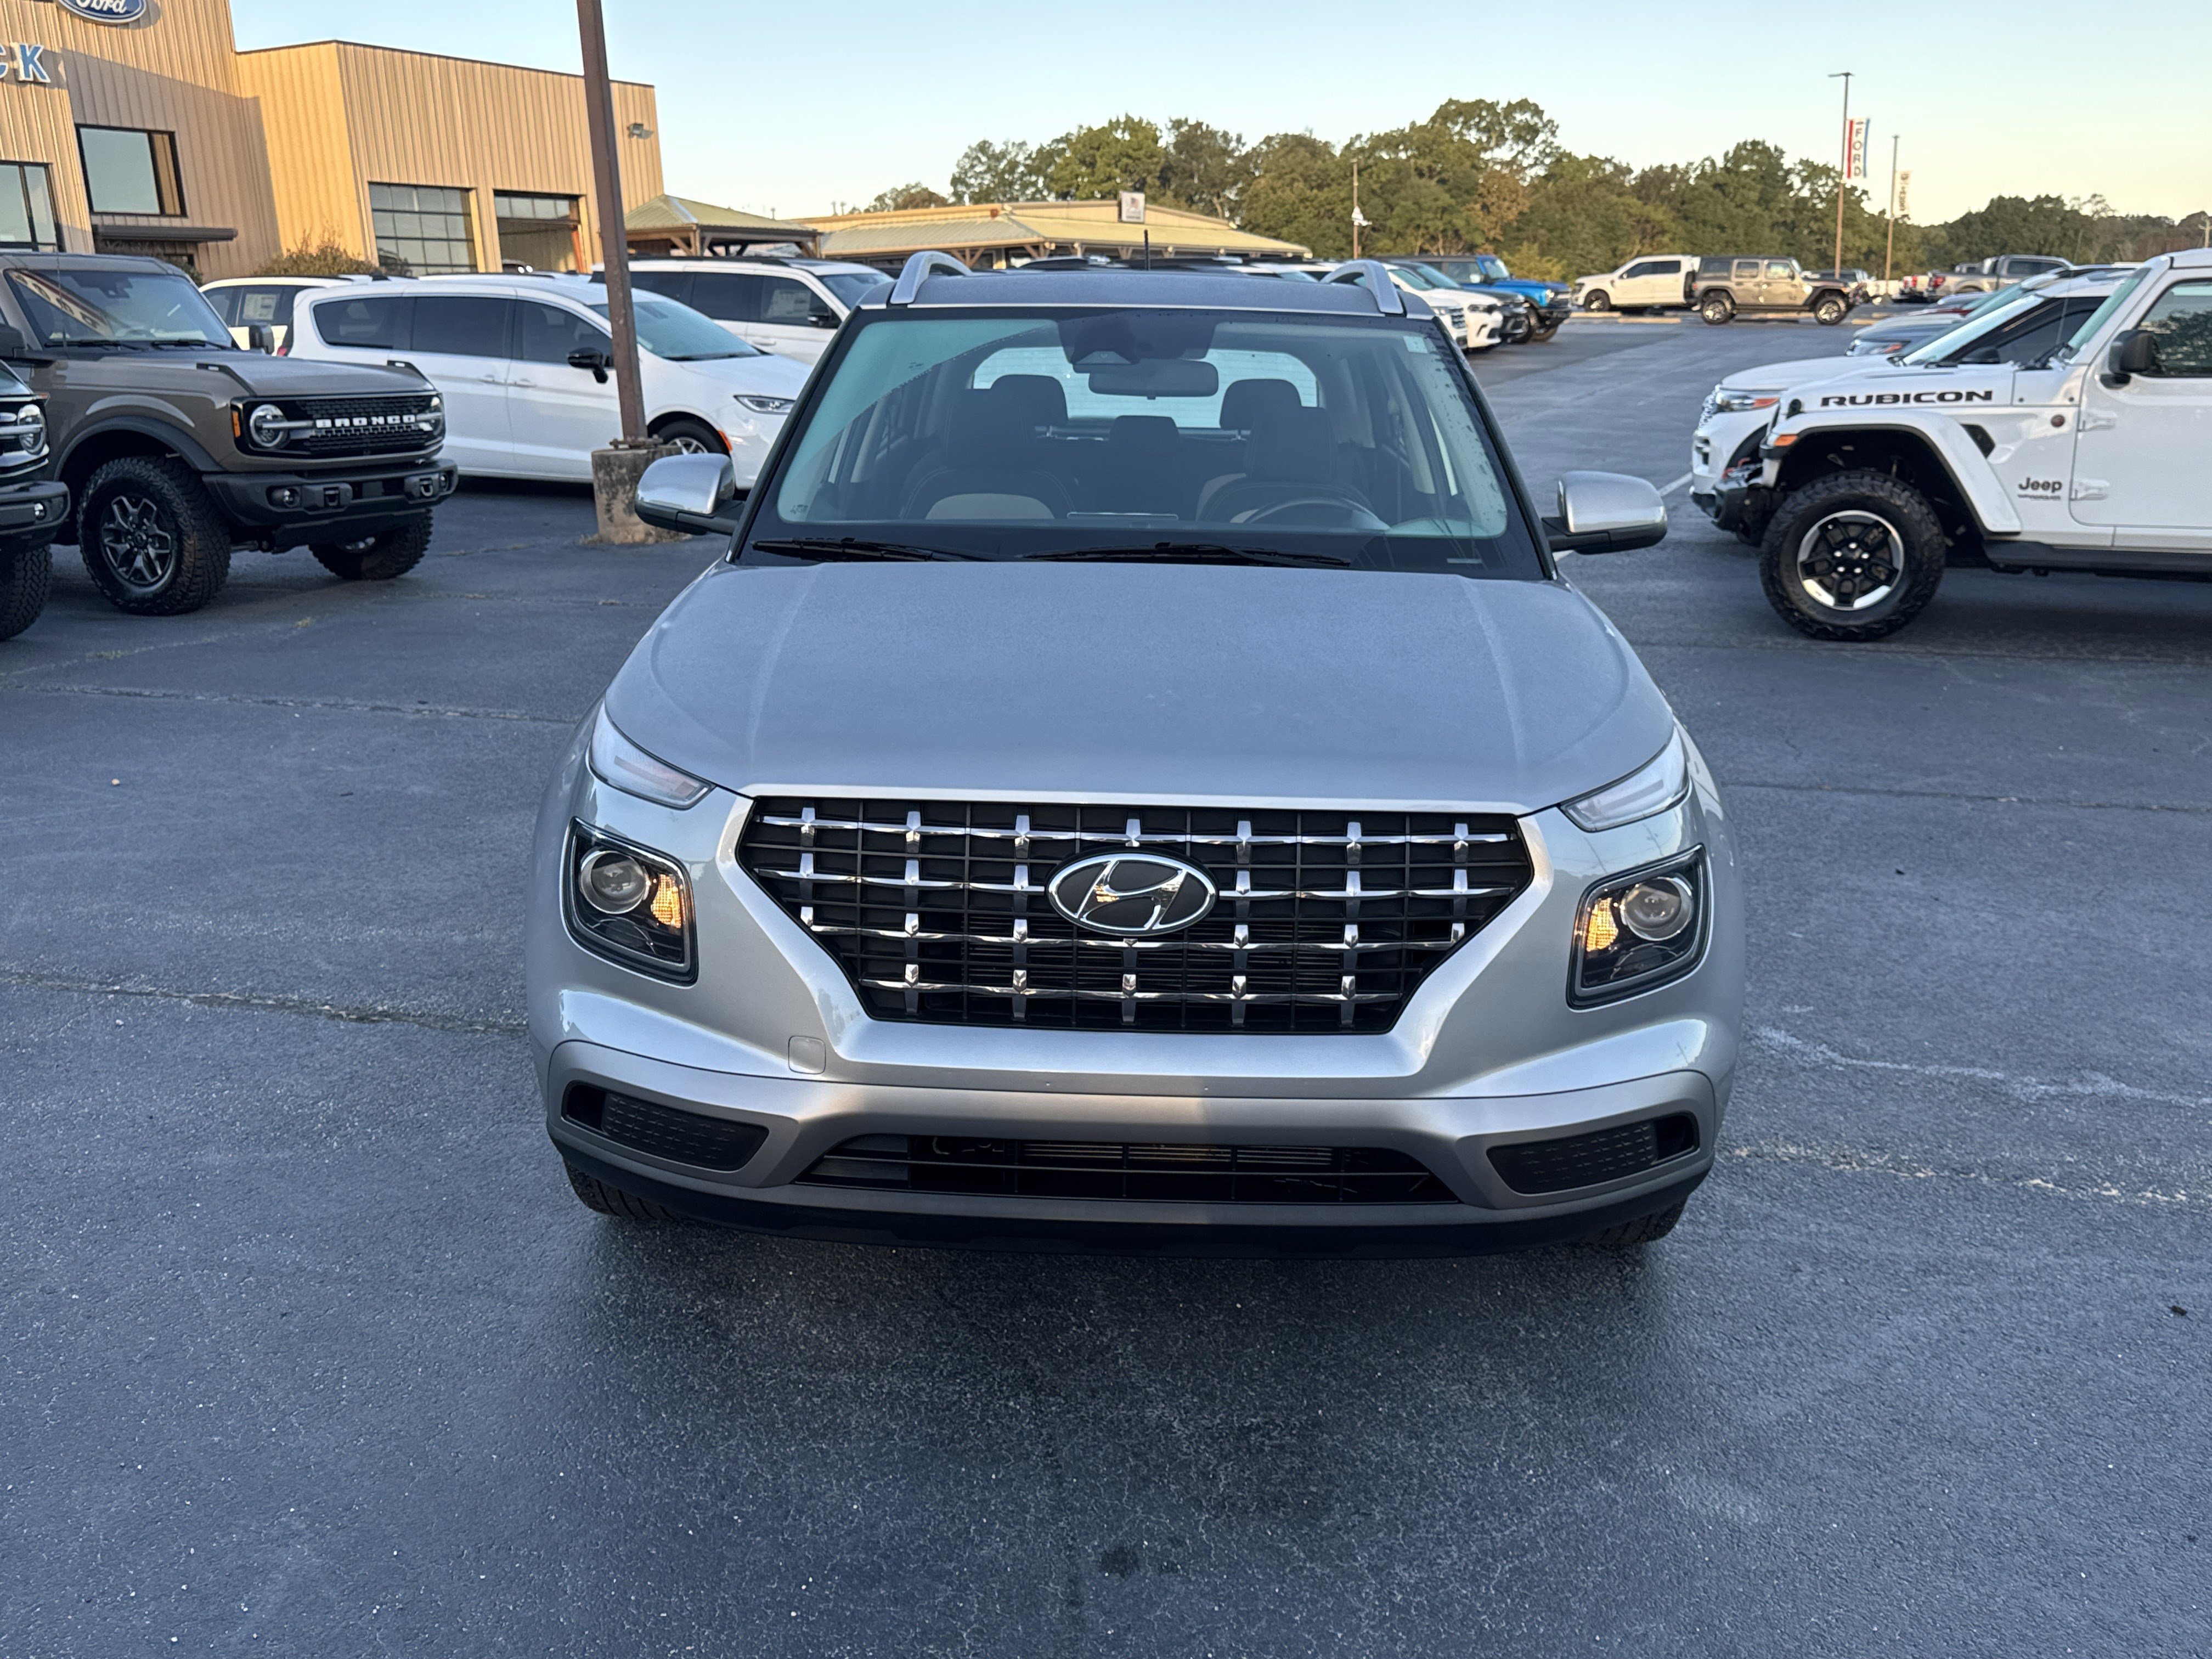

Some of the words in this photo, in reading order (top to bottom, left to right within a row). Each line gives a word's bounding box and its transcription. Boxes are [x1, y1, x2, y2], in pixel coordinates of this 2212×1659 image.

[1852, 127, 1863, 177] FORD
[1820, 390, 1993, 407] RUBICON
[315, 414, 415, 428] BRONCO
[2018, 478, 2062, 493] Jeep
